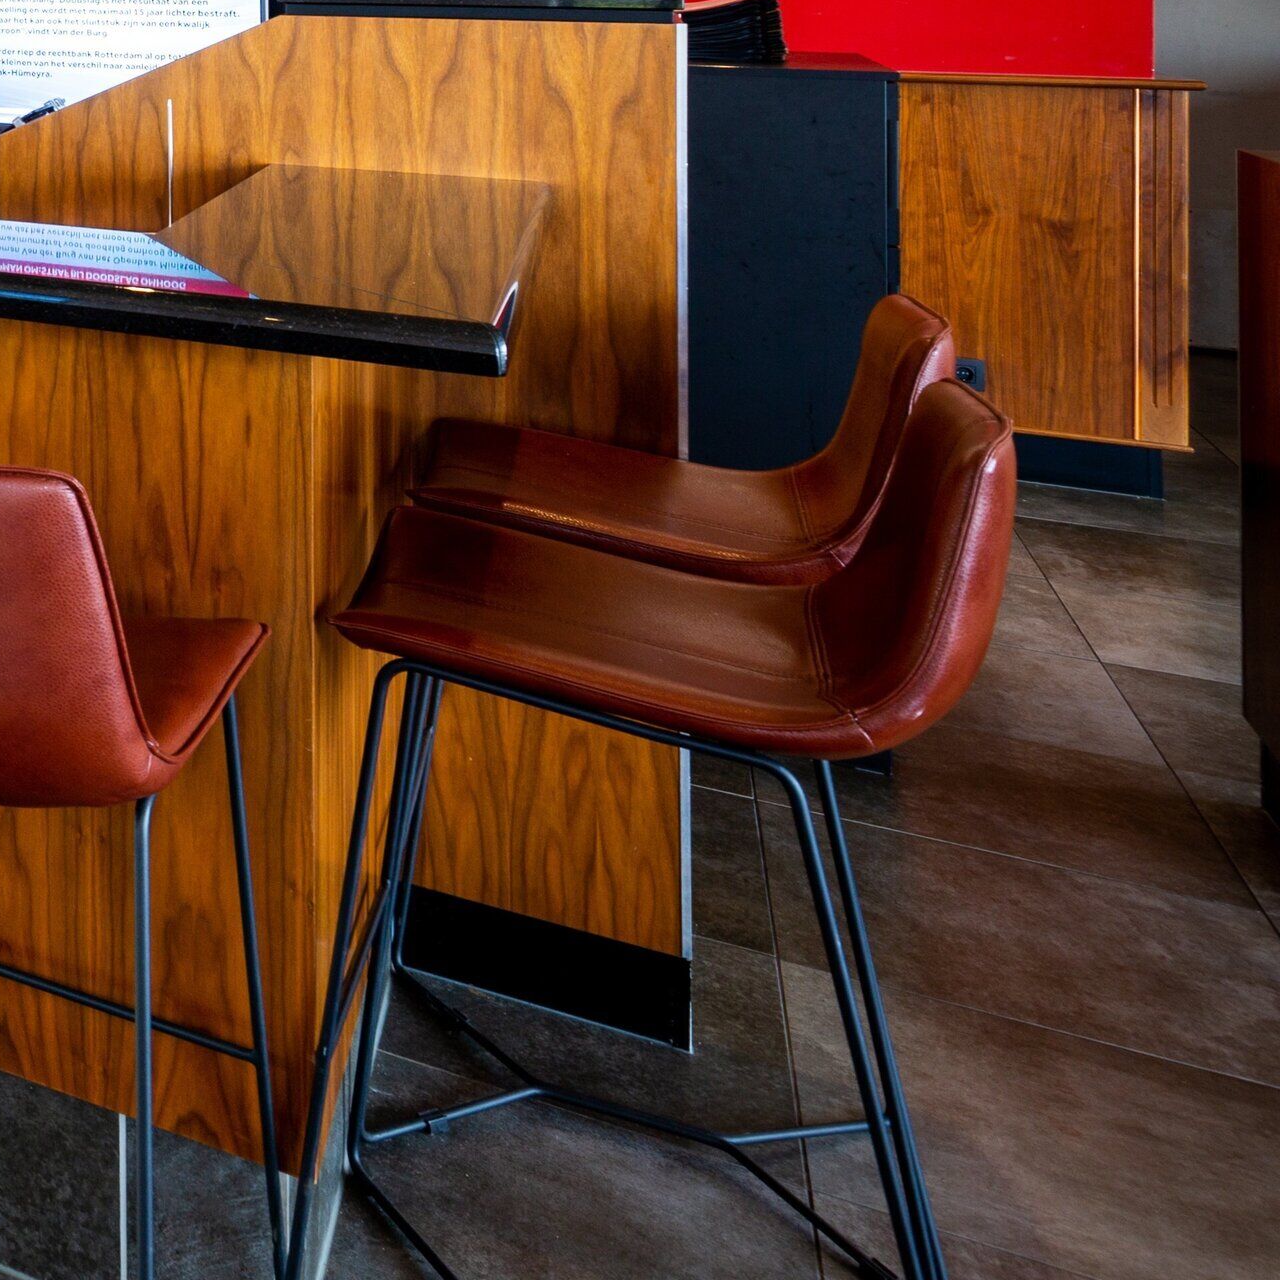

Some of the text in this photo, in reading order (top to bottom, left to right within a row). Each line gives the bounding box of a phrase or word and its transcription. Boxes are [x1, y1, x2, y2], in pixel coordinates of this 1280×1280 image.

[146, 9, 163, 17] jaar
[178, 20, 210, 29] kwalijk
[17, 48, 34, 57] riep
[48, 50, 91, 58] rechtbank
[95, 51, 142, 59] Rotterdam
[145, 52, 152, 60] al
